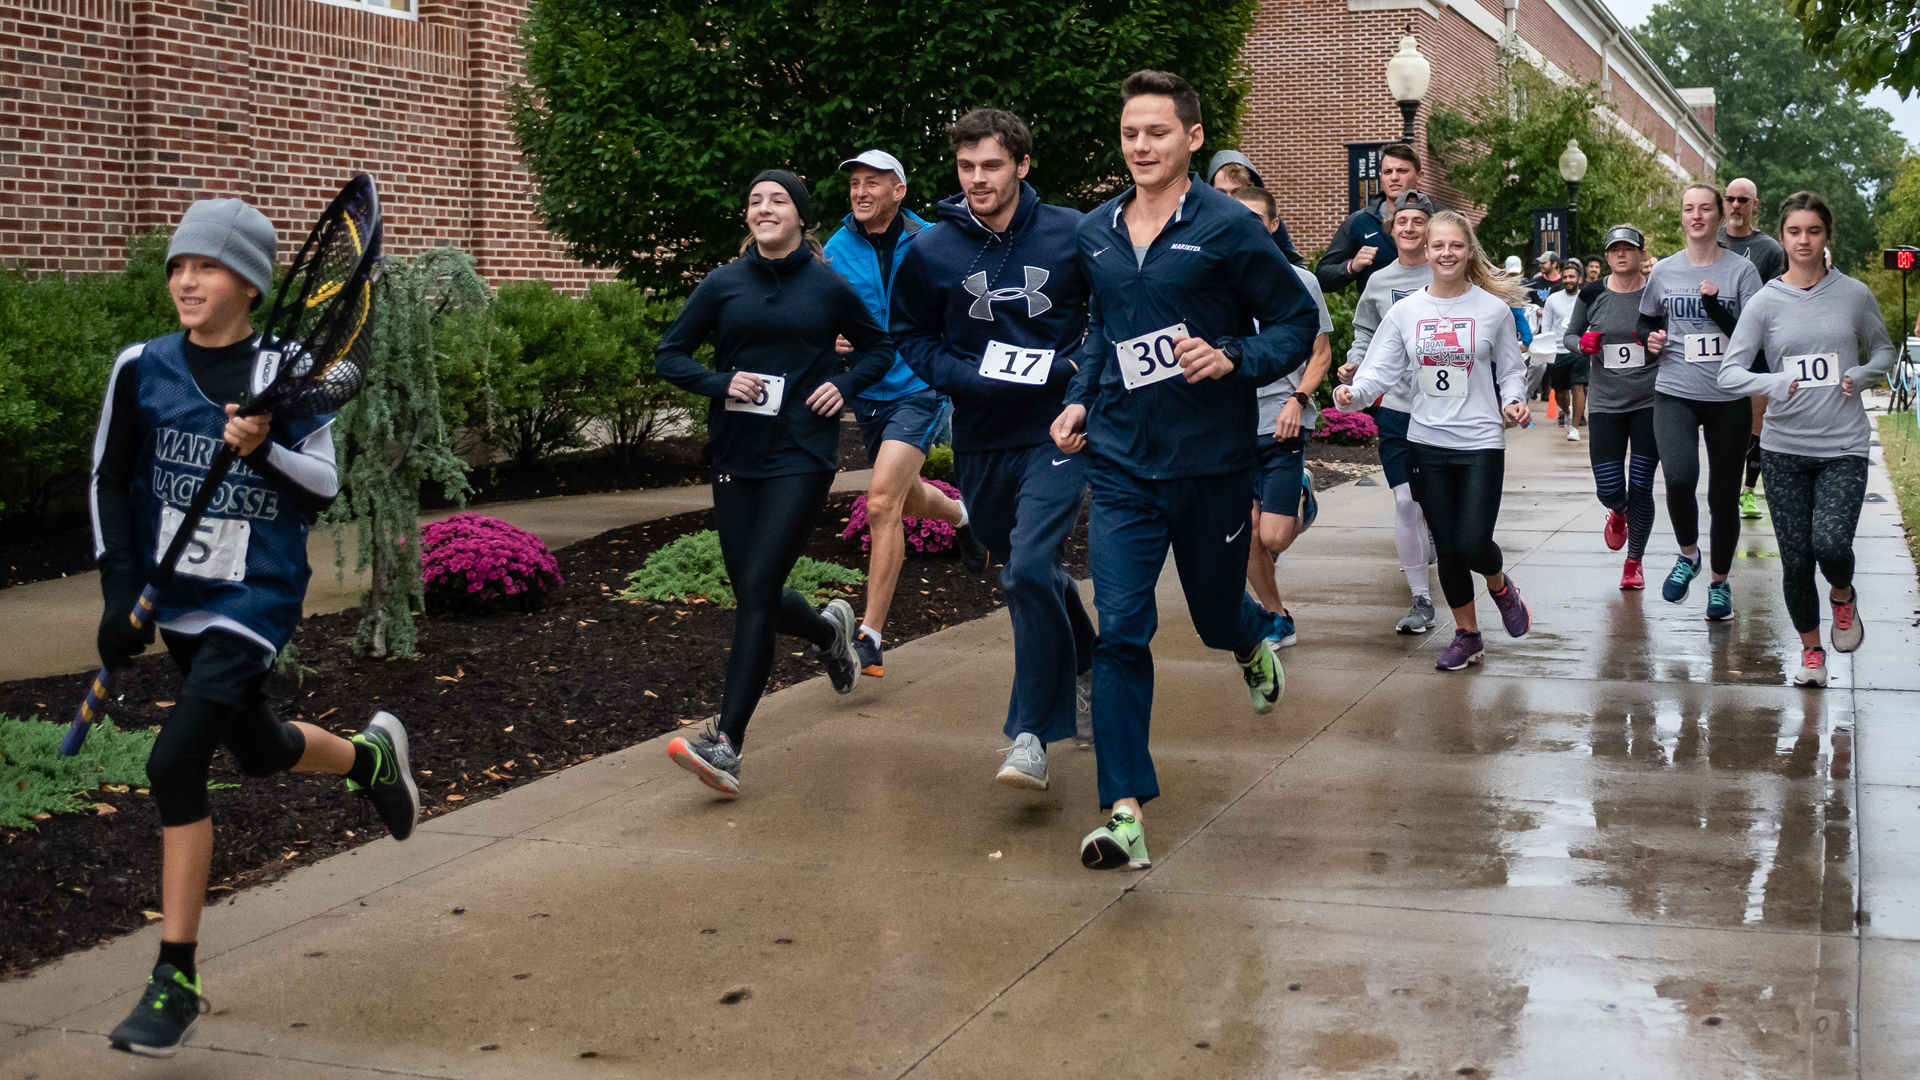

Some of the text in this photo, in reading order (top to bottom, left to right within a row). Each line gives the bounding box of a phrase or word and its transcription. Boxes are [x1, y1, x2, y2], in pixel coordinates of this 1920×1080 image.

[1358, 158, 1366, 178] THIS
[1368, 151, 1376, 178] IS THE
[1170, 243, 1201, 252] MARIETTA
[1132, 334, 1180, 377] 30
[1619, 347, 1631, 365] 9
[1697, 337, 1723, 357] 11
[262, 353, 275, 384] UNDER
[999, 350, 1043, 377] 17
[1797, 357, 1828, 383] 10
[1436, 370, 1451, 391] 8
[188, 526, 213, 564] 5
